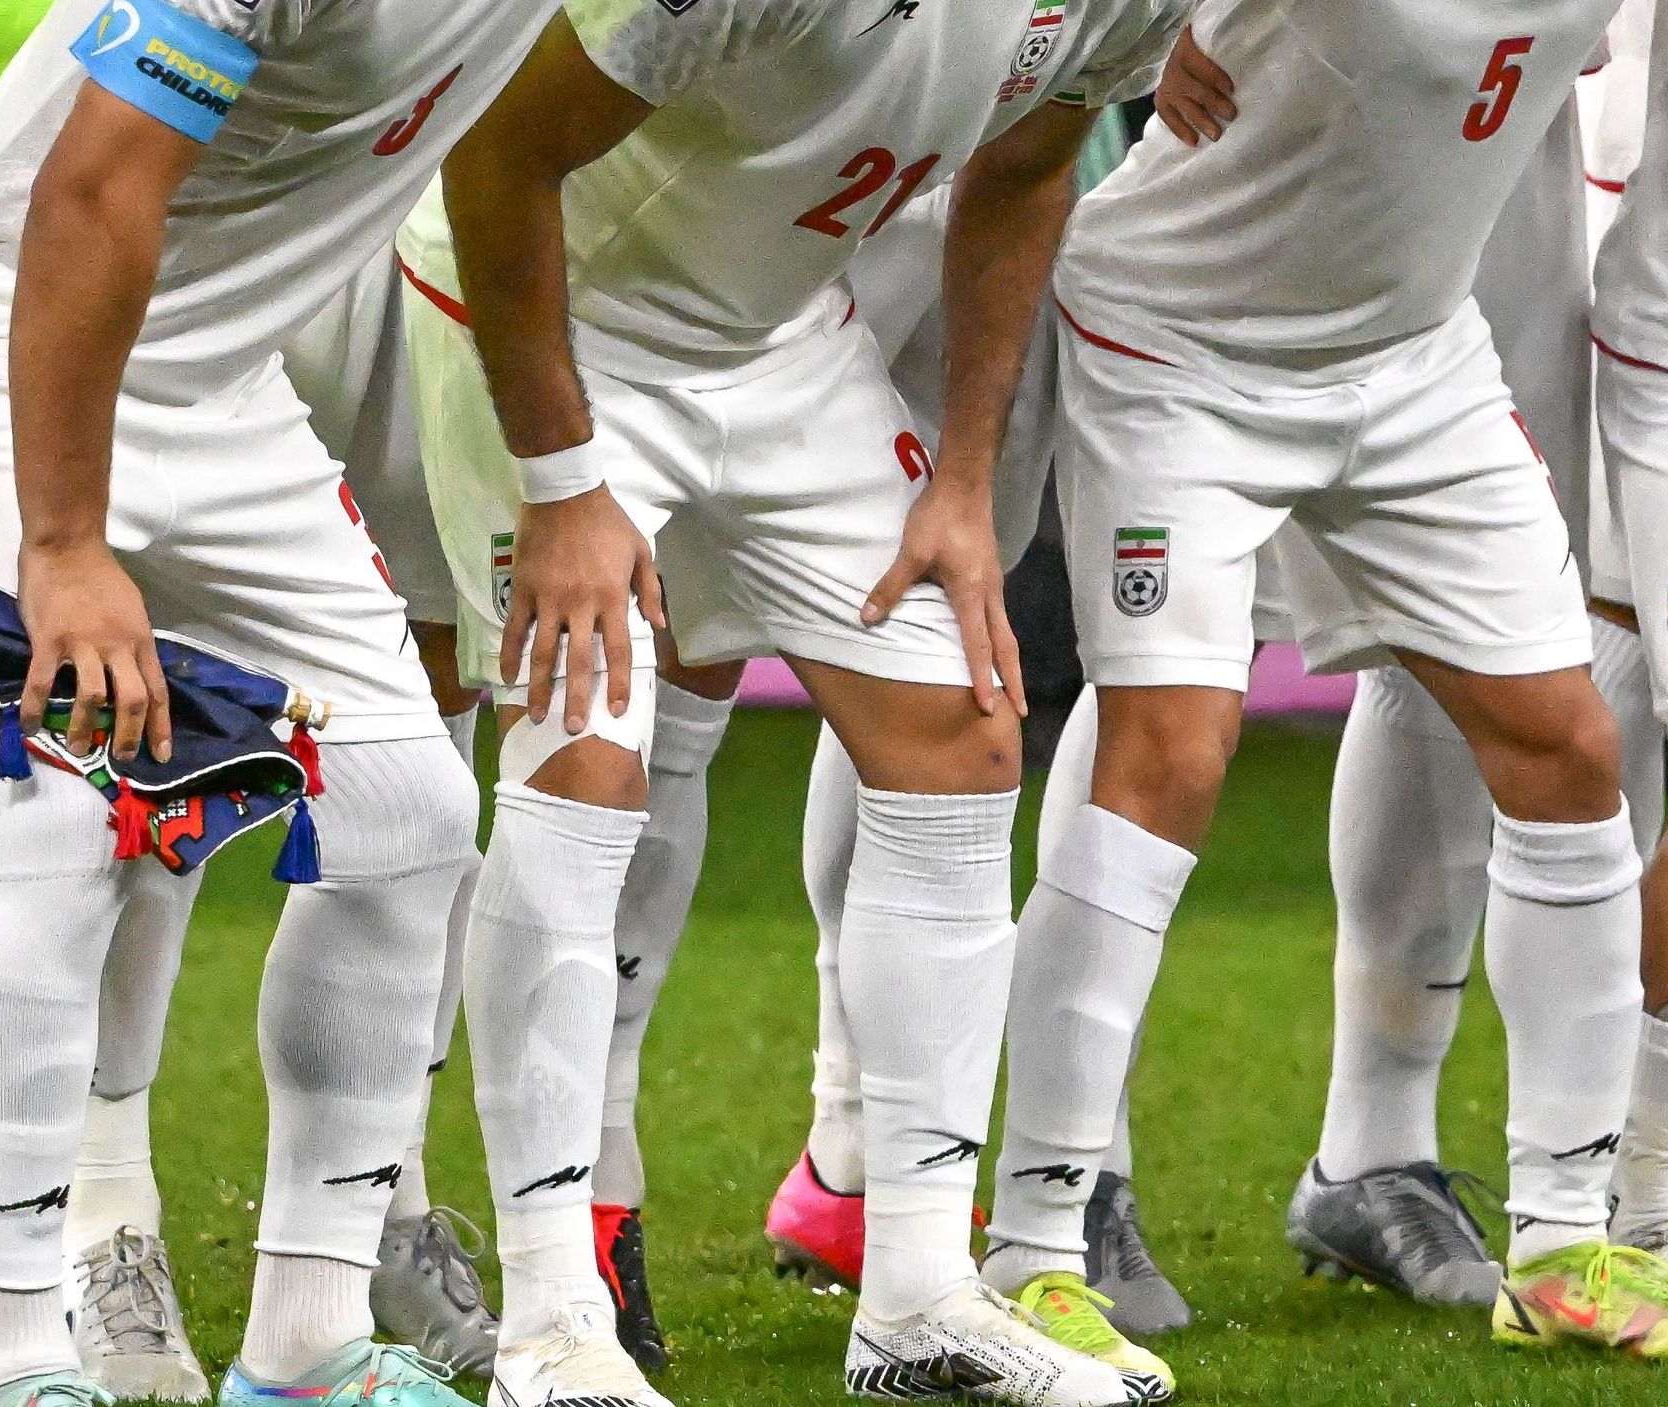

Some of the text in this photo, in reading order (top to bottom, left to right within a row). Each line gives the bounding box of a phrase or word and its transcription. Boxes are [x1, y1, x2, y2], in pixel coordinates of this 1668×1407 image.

[145, 38, 246, 99] PROTE
[1462, 36, 1534, 142] 5
[793, 147, 942, 239] 21
